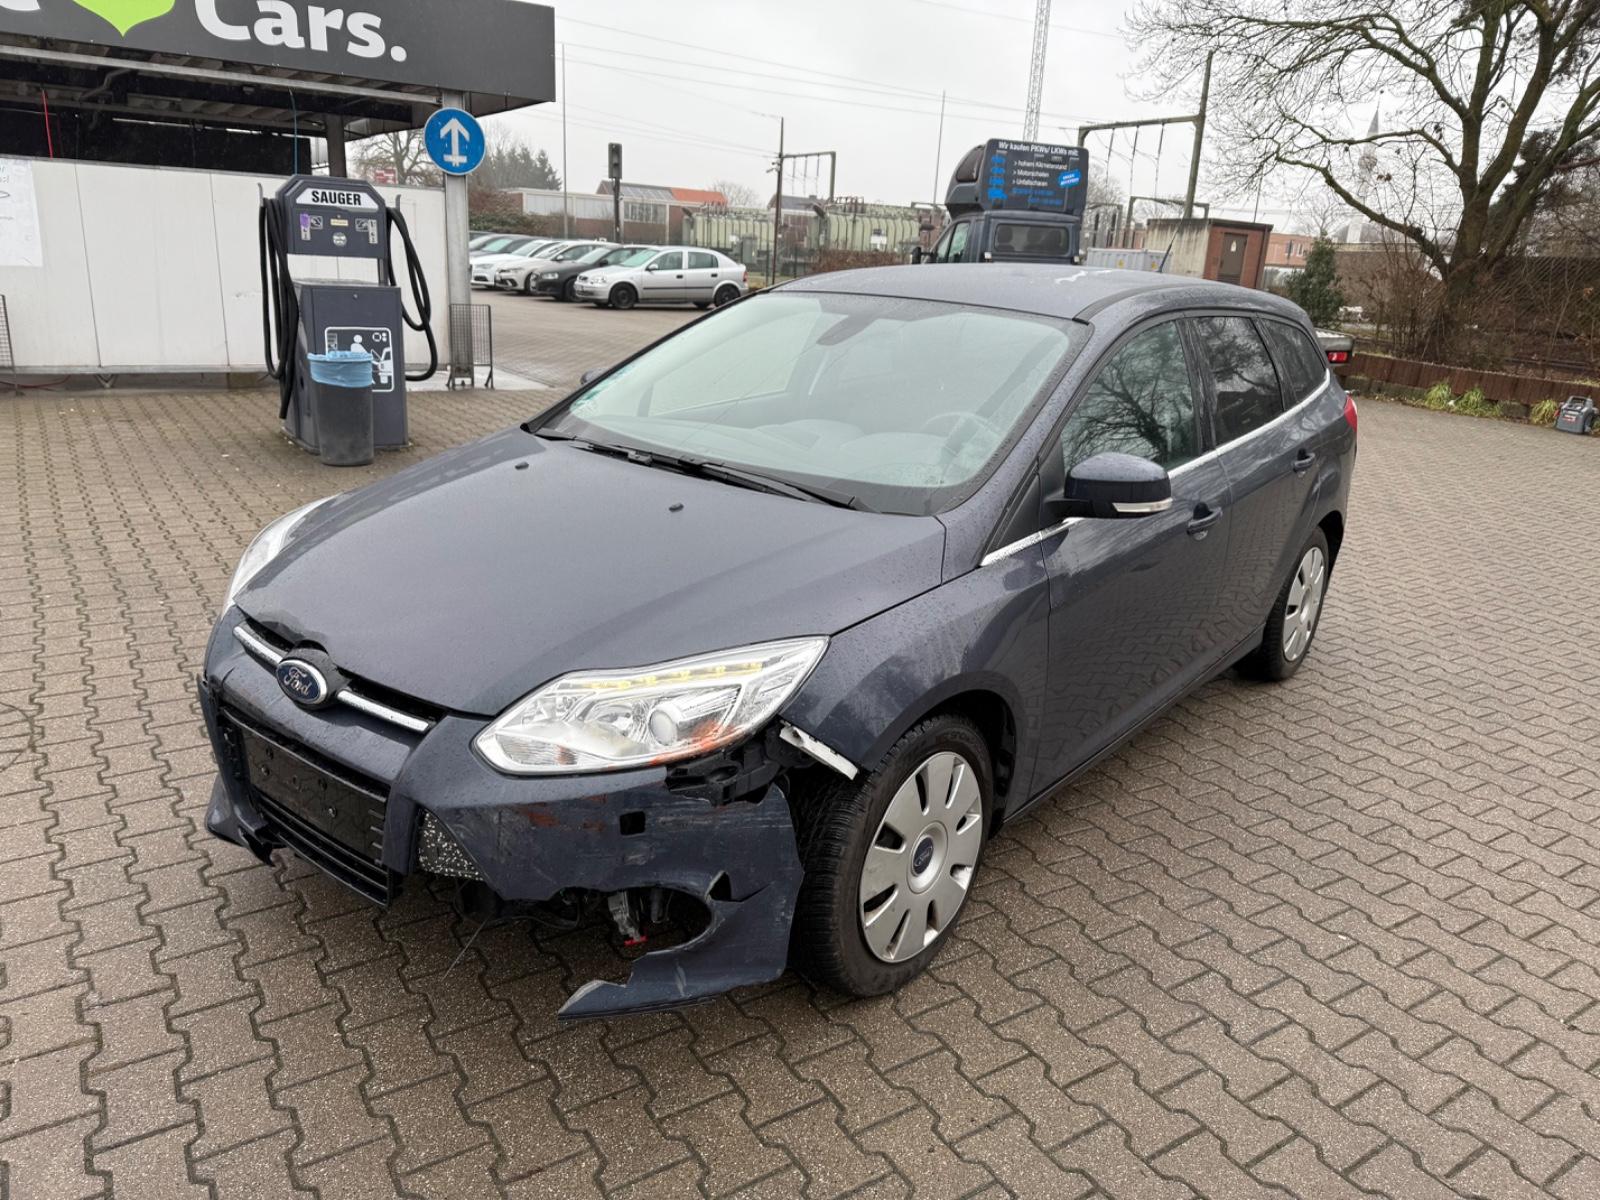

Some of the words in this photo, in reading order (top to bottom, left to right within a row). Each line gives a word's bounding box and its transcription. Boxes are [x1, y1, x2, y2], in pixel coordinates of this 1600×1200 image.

[194, 0, 407, 62] Cars.
[998, 142, 1008, 150] Wir
[1009, 143, 1030, 152] kaufen
[311, 190, 362, 206] SAUGER
[283, 667, 312, 696] Ford
